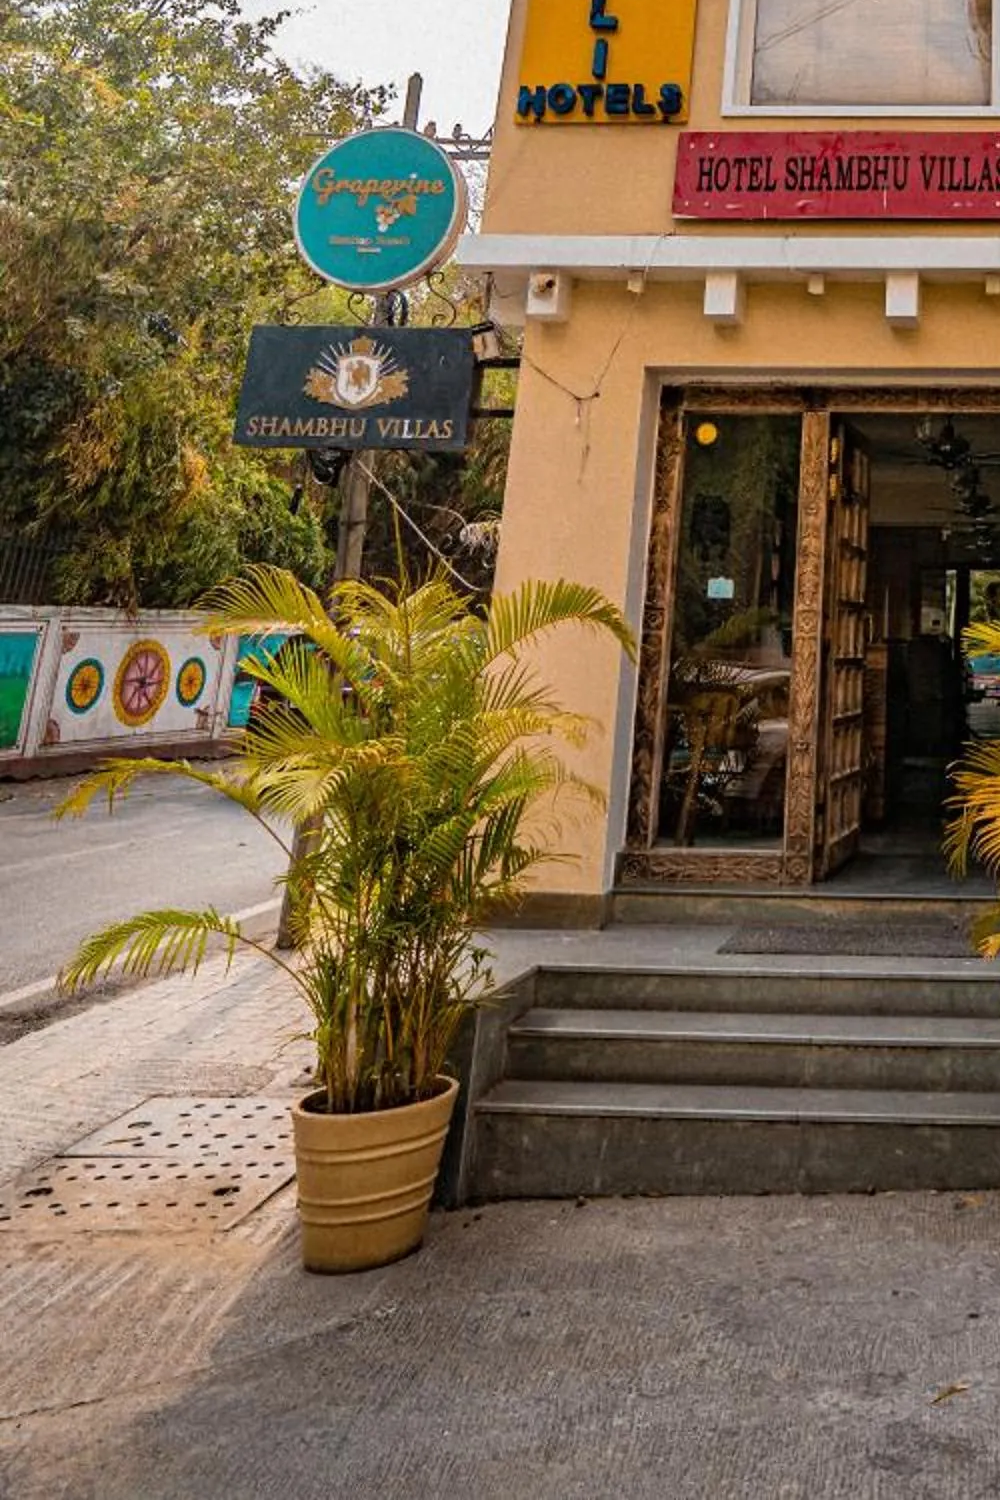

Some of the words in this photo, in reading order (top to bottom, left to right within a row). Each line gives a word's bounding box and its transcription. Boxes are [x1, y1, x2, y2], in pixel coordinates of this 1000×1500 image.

[516, 83, 683, 119] HOTELS
[312, 167, 446, 206] Grapevine
[696, 156, 777, 193] HOTEL
[784, 155, 911, 192] SHAMBHU
[245, 416, 368, 439] SHAMBHU
[377, 417, 454, 440] VILLAS
